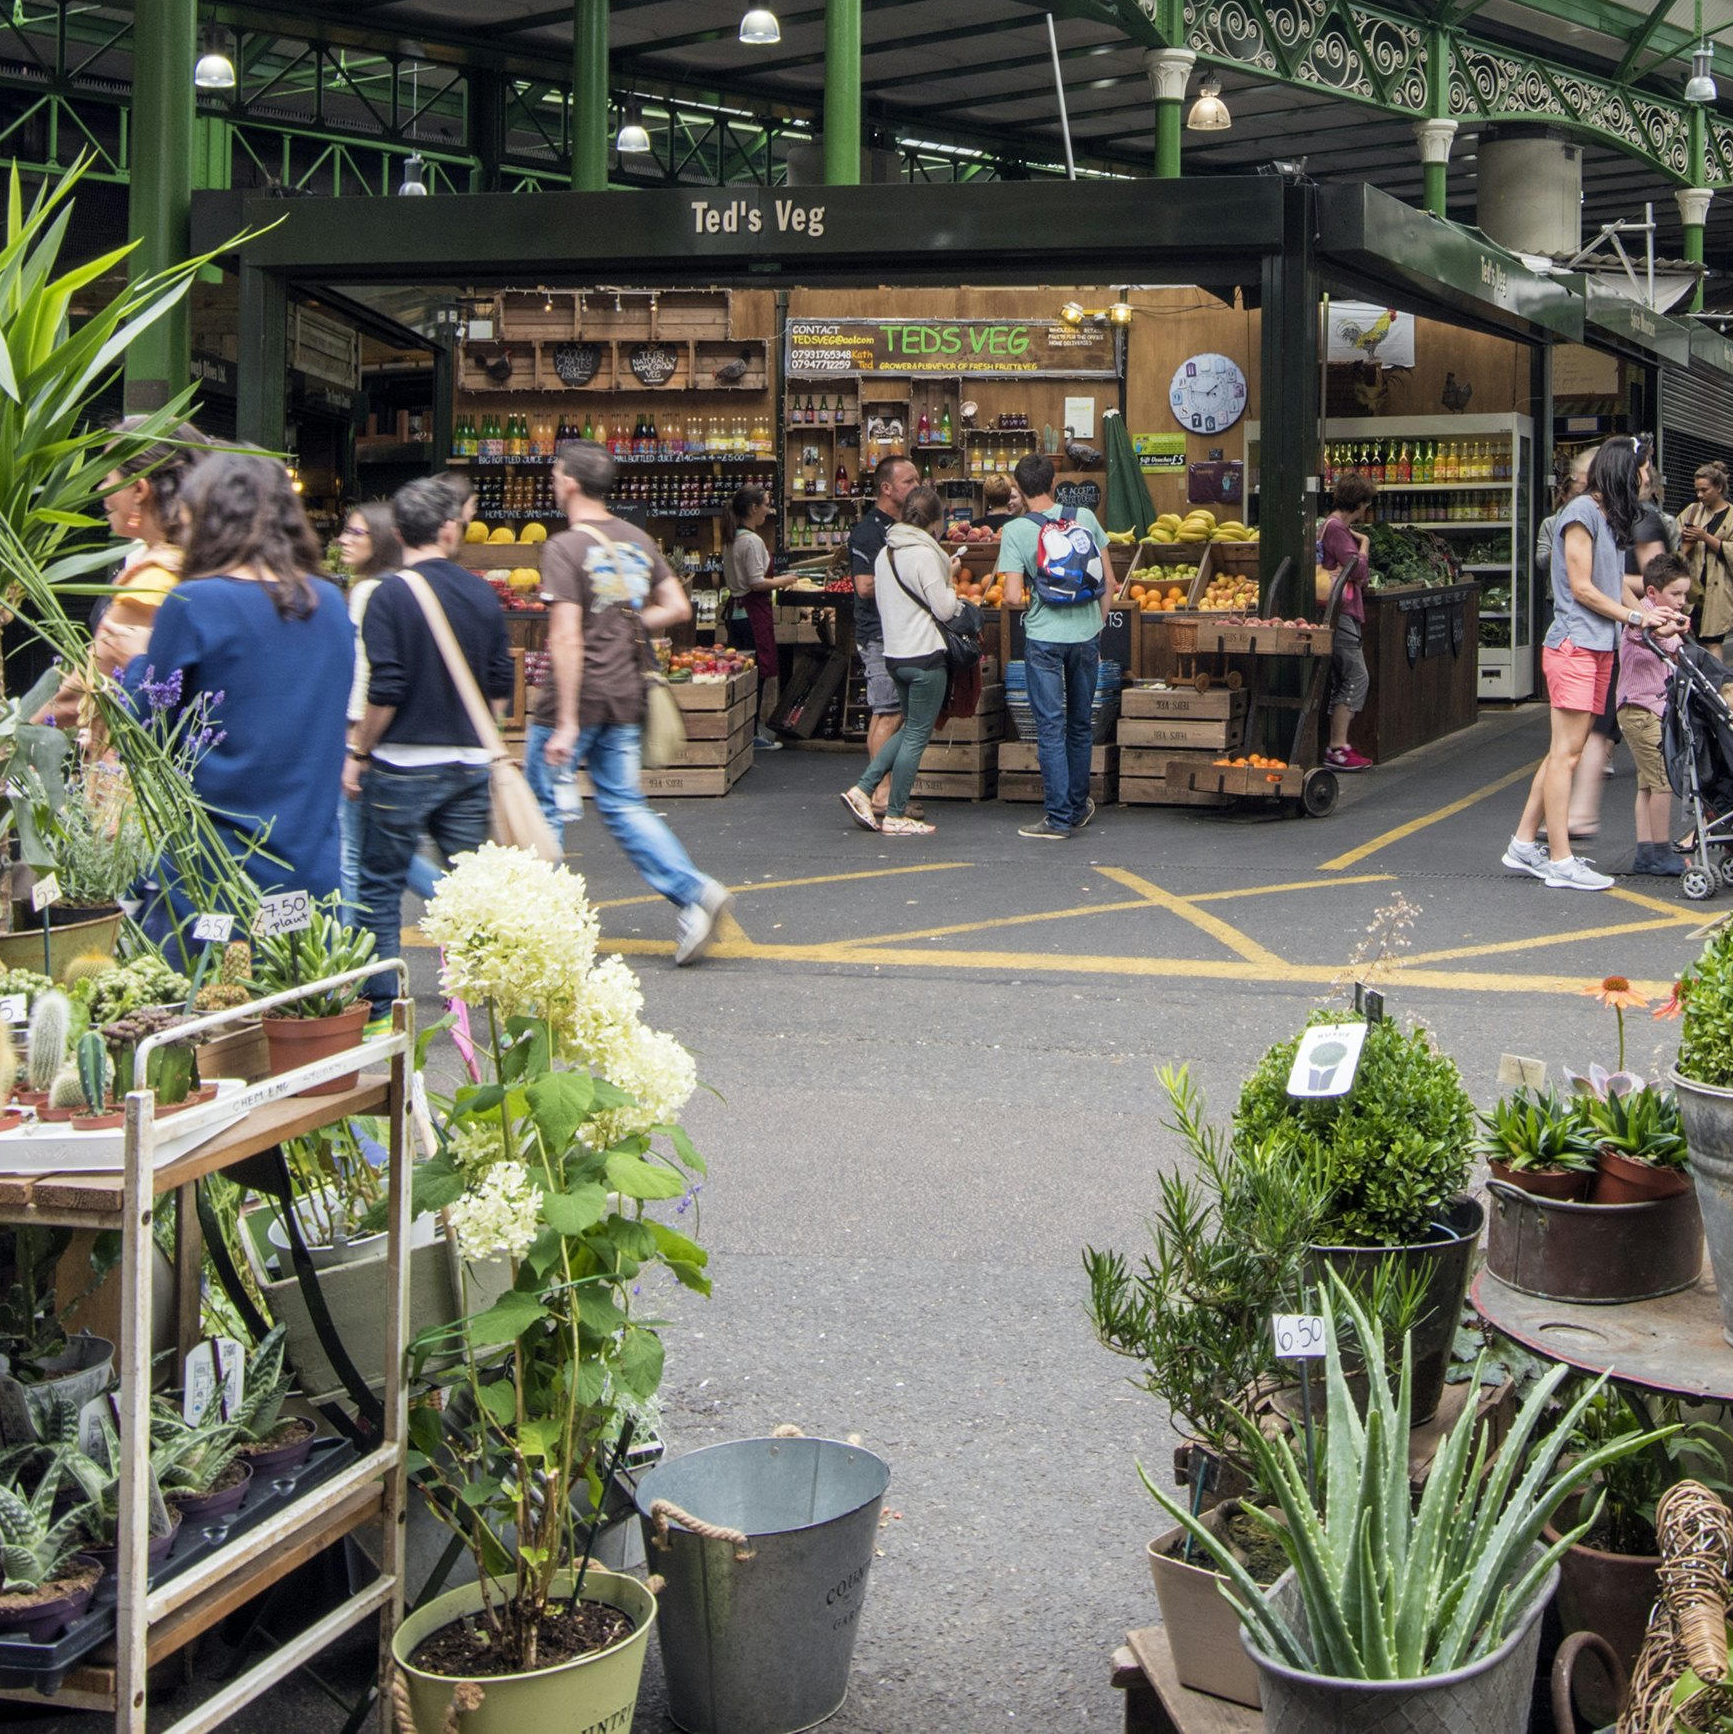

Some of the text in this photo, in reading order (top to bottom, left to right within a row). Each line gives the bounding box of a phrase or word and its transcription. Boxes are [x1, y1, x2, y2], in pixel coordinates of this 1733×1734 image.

[691, 199, 826, 237] Ted's Veg
[792, 325, 841, 335] CONTACT
[969, 326, 1030, 356] VEG
[791, 349, 874, 360] 07931765348 Kath
[857, 360, 875, 370] Ted
[969, 362, 995, 371] FRESH
[645, 370, 661, 379] VEG
[491, 455, 521, 465] BOTTLED
[522, 455, 544, 464] JUICE
[1171, 453, 1185, 466] £5
[1056, 485, 1096, 497] WE ACCEPT
[484, 509, 522, 519] HOMEMADE
[260, 896, 306, 918] 7.50
[269, 912, 308, 933] plant
[232, 1091, 264, 1112] CHEM
[1276, 1313, 1323, 1352] 6.50
